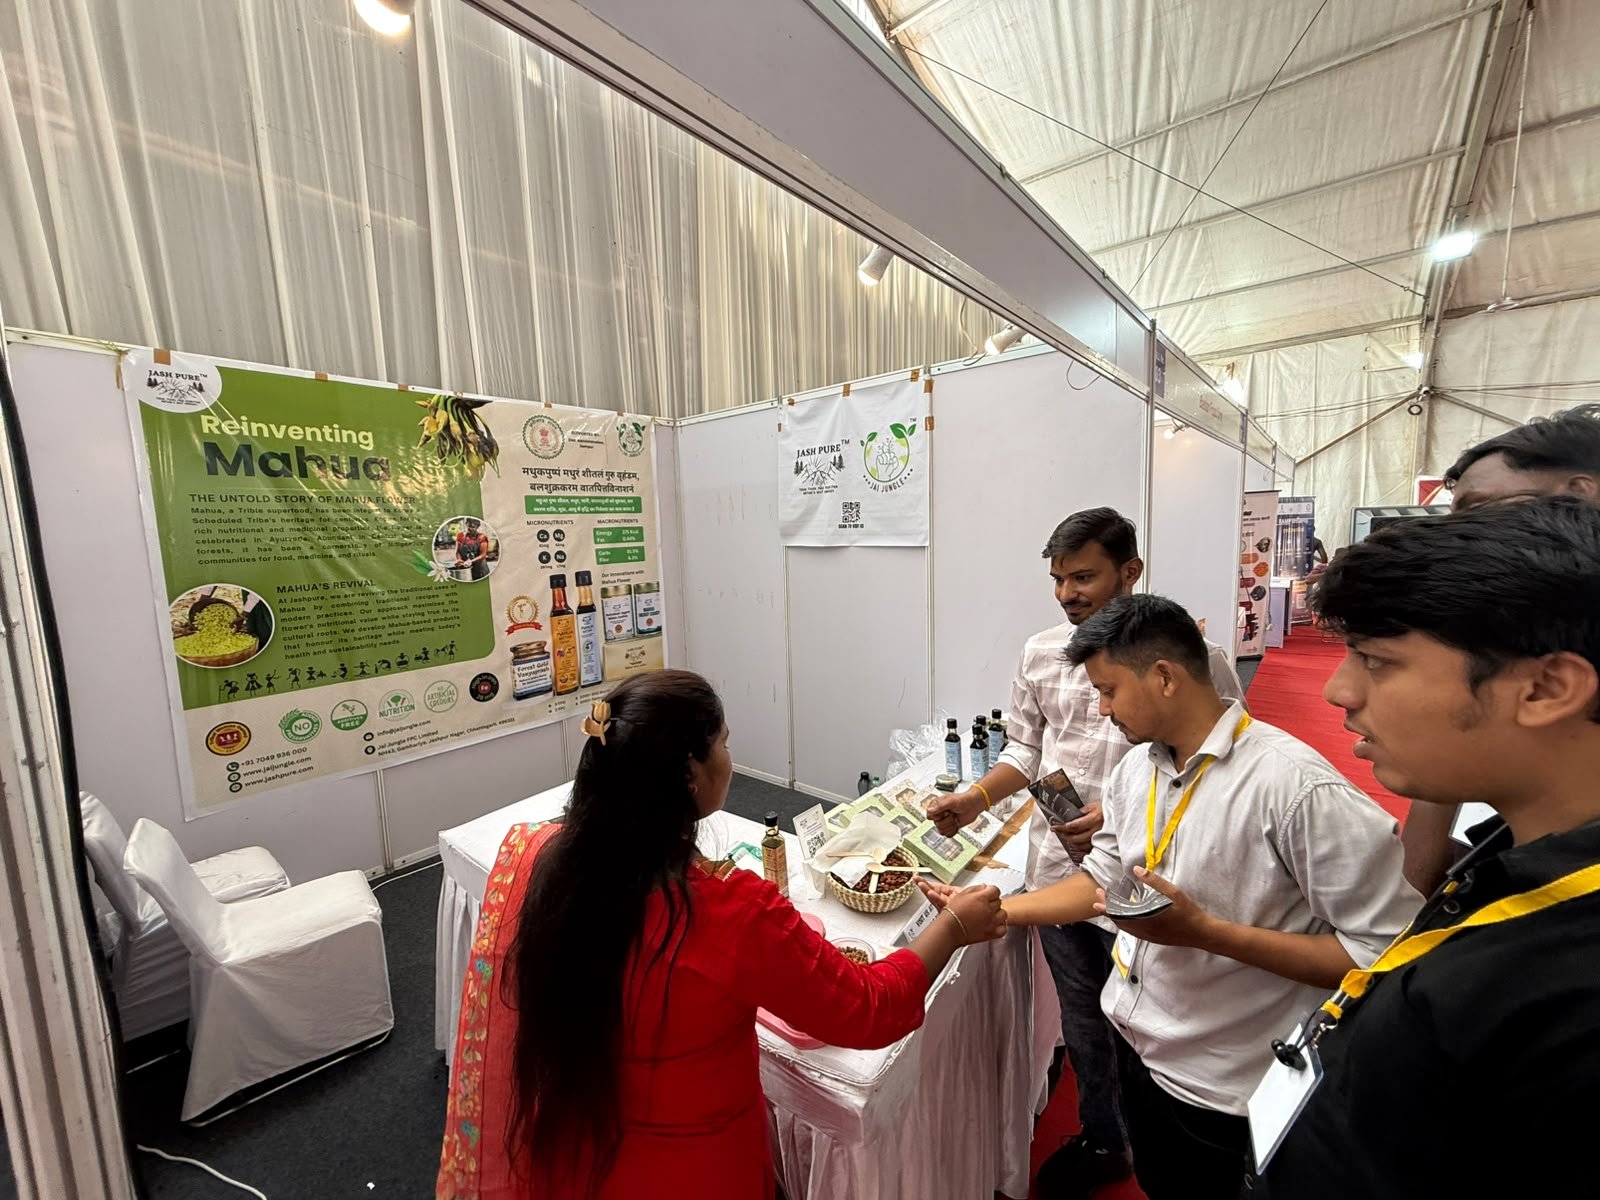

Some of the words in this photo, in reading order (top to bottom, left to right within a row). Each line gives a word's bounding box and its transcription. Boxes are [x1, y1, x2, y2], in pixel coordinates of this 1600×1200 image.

[149, 370, 172, 378] JASH
[201, 414, 373, 450] Reinventing
[797, 447, 816, 459] JASH
[204, 441, 390, 481] Mahua
[870, 482, 879, 492] JAI
[881, 477, 904, 493] JUNGLE
[189, 494, 215, 503] THE
[220, 494, 270, 503] UNTOLD
[274, 495, 313, 503] STORY
[318, 495, 332, 503] OF
[336, 495, 372, 504] MAHUA
[376, 496, 416, 504] FLOWER
[191, 507, 225, 515] Mahua,
[267, 507, 312, 515] superfood,
[196, 537, 246, 545] celebrated
[554, 532, 563, 540] Mg
[198, 557, 256, 565] communities
[277, 582, 330, 593] MAHUA'S
[333, 579, 376, 590] REVIVAL
[400, 586, 433, 594] traditional
[280, 606, 306, 614] Mahua
[331, 600, 369, 609] combining
[376, 596, 410, 604] traditional
[281, 615, 311, 623] modern
[378, 605, 408, 613] approach
[282, 623, 313, 632] flower's
[318, 619, 356, 628] nutritional
[402, 611, 425, 619] staying
[283, 632, 314, 642] cultural
[317, 630, 339, 638] roots.
[358, 624, 385, 632] develop
[388, 618, 431, 628] Mahua-based
[433, 615, 460, 623] products
[306, 639, 333, 648] honour
[353, 633, 382, 641] heritage
[285, 652, 310, 660] health
[329, 642, 377, 653] sustainability
[517, 662, 536, 672] Forest
[428, 689, 455, 701] ARTIFICIAL
[379, 704, 415, 718] NUTRITION
[294, 722, 310, 732] NO
[341, 720, 361, 728] FREE
[388, 739, 406, 747] Jungle
[418, 730, 438, 739] Limited
[256, 754, 275, 764] 7049
[276, 751, 290, 759] 936
[292, 746, 307, 755] 000
[243, 756, 312, 777] www.jaijungle.com
[245, 765, 313, 787] www.jashpure.com
[916, 914, 925, 927] VISIT
